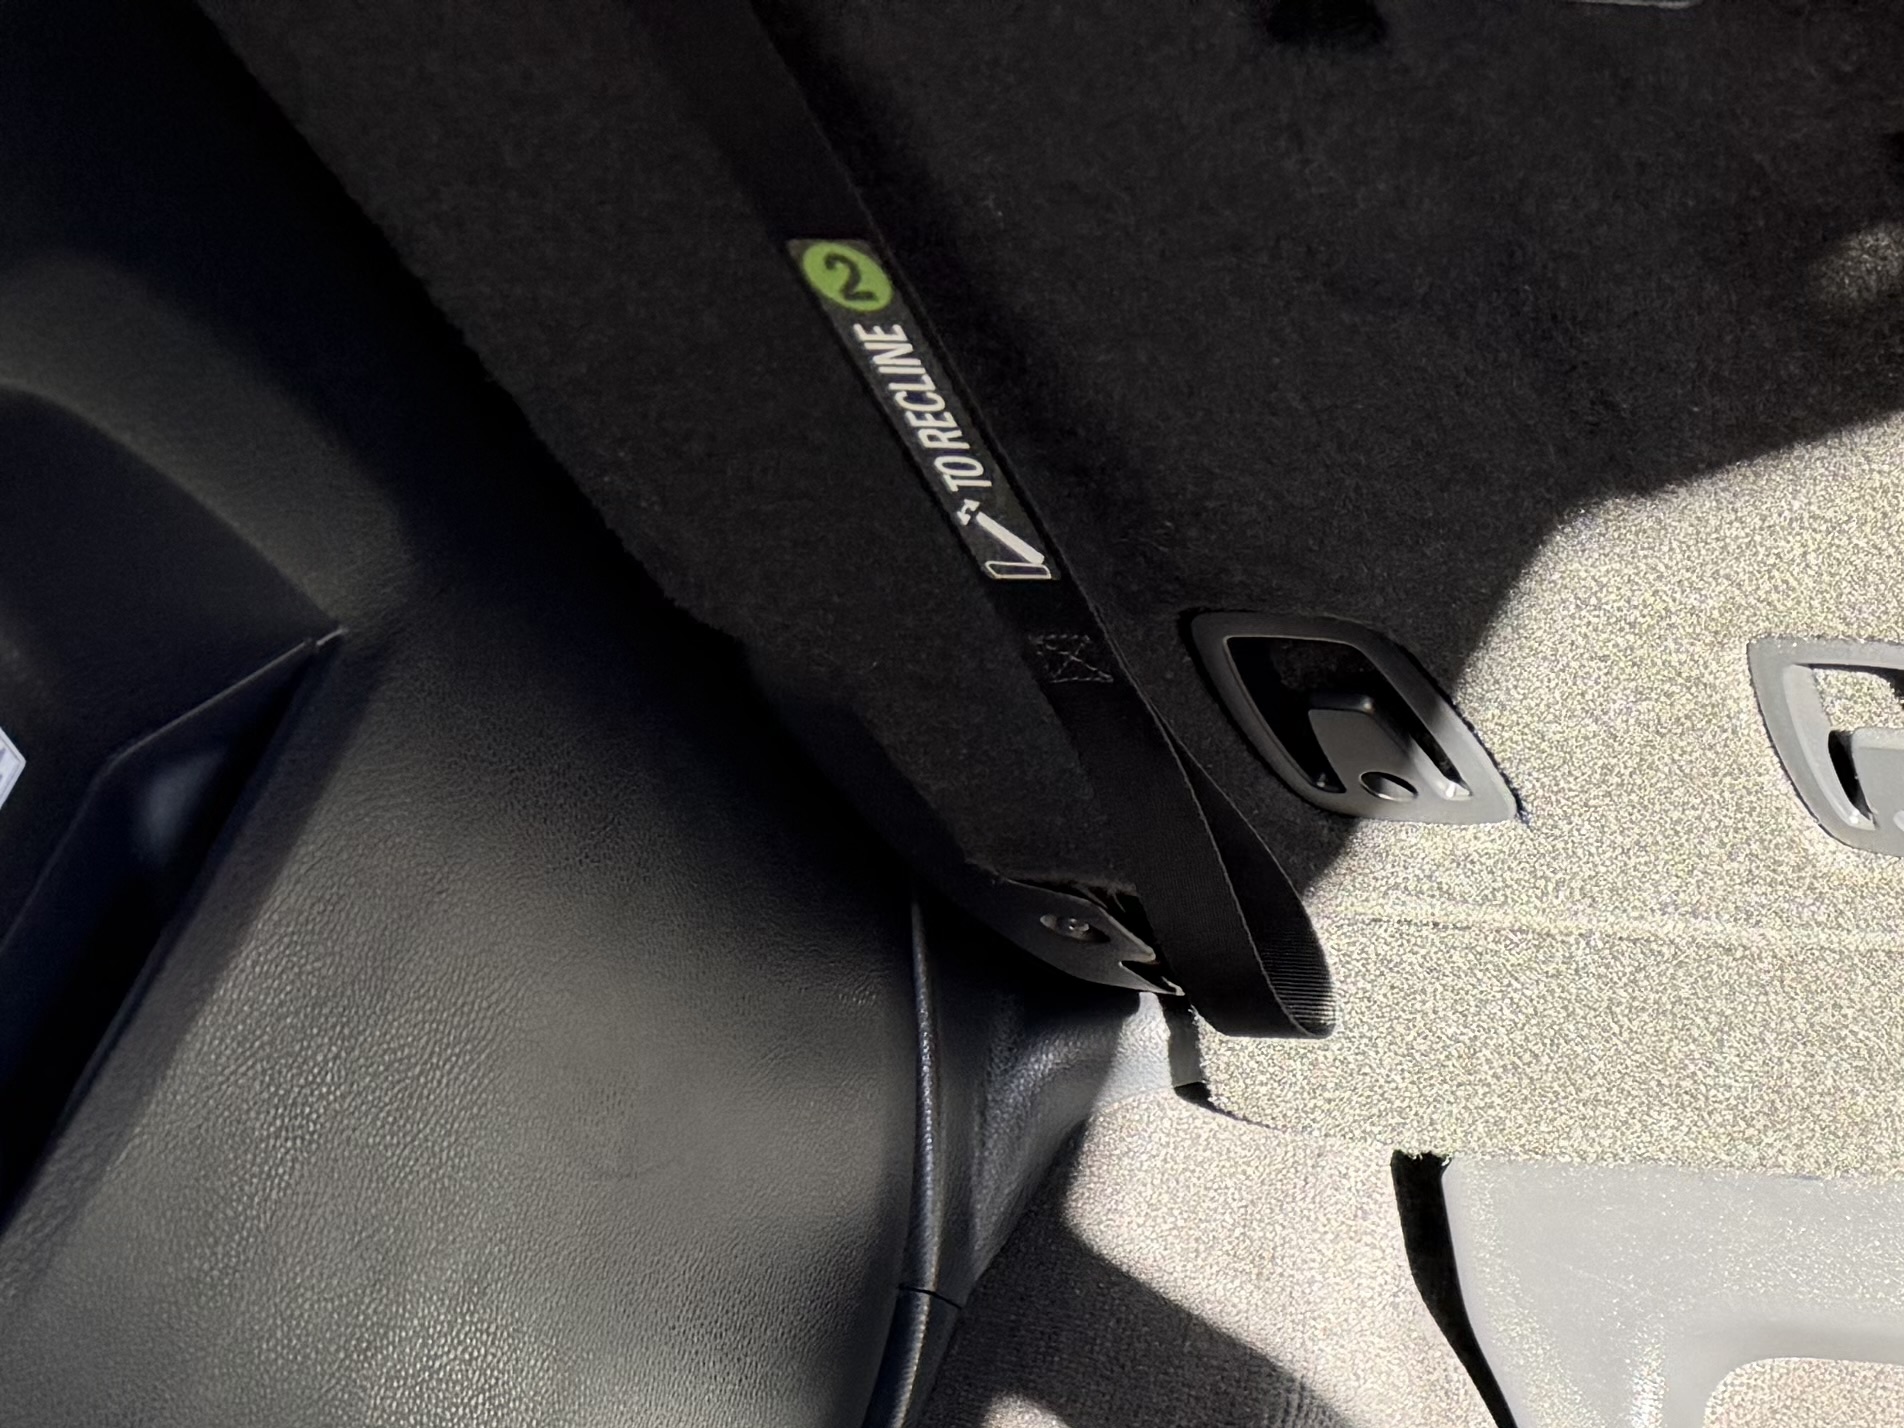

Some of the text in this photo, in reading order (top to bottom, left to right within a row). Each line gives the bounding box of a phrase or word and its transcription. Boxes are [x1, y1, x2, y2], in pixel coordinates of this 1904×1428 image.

[824, 253, 879, 303] 2
[853, 322, 993, 493] TO RECLINE
